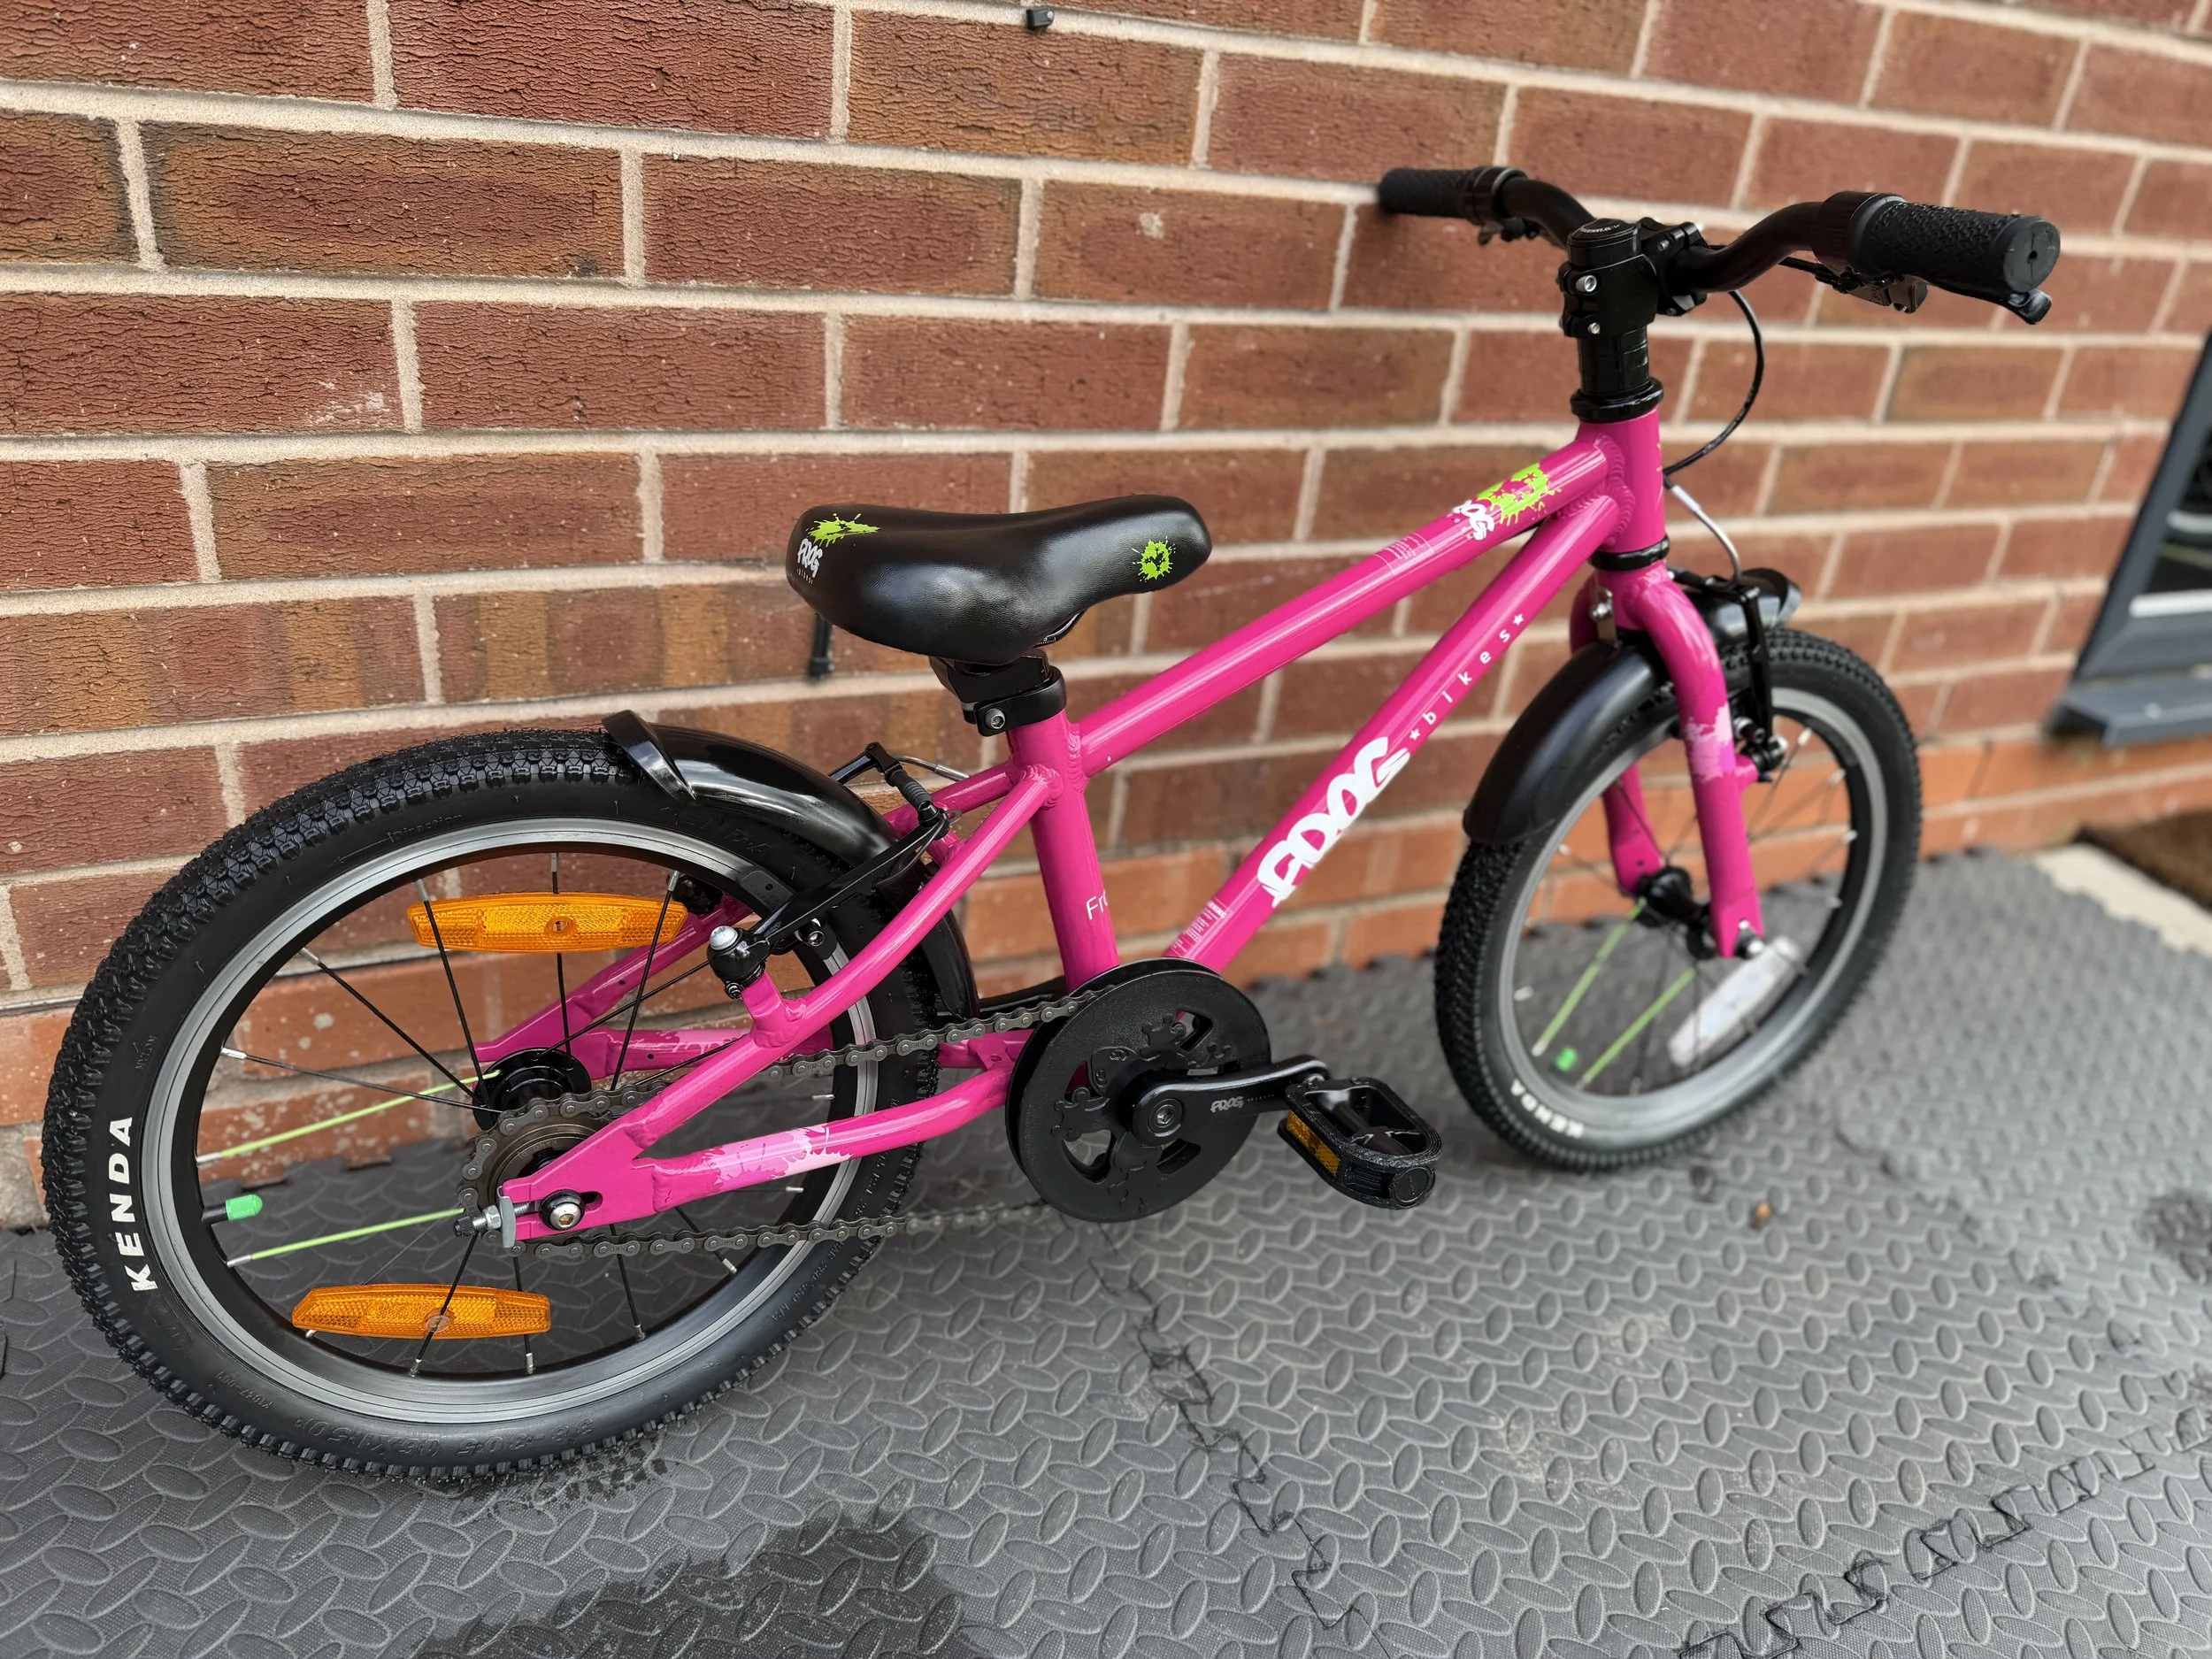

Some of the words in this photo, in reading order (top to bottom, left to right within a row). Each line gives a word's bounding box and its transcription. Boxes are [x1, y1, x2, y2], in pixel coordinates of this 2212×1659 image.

[797, 538, 824, 578] FROG
[1422, 628, 1513, 726] bikes
[1257, 736, 1410, 908] FROG
[1210, 1095, 1244, 1113] FROG
[1509, 1079, 1585, 1140] KENDA
[106, 1117, 159, 1293] KENDA
